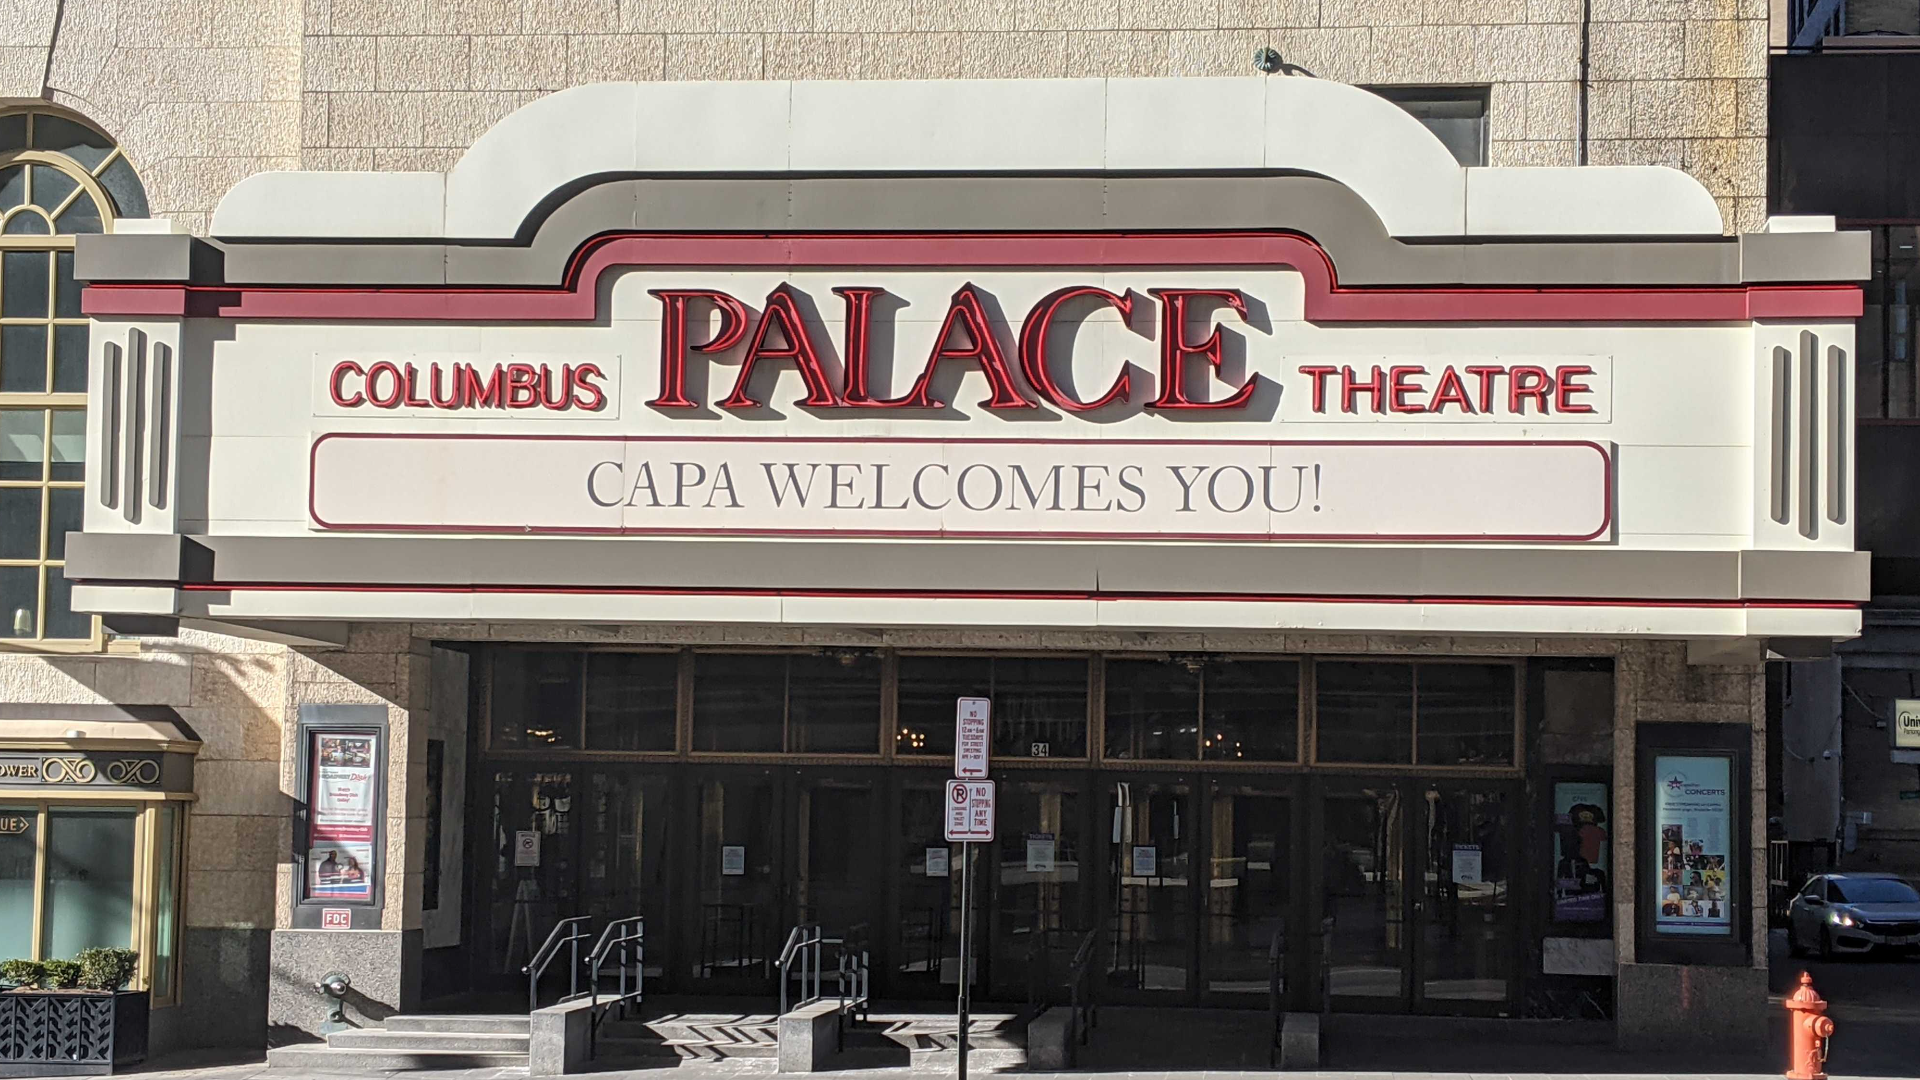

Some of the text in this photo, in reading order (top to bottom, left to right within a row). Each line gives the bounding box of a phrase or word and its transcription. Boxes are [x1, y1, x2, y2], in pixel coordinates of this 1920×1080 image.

[329, 281, 1593, 414] COLUMBUS PALACE THEATRE
[587, 461, 1321, 512] CAPA WELCOMES YOU!
[969, 710, 977, 718] NO
[962, 718, 985, 726] STOPPING
[1903, 715, 1920, 728] Uni
[1033, 744, 1048, 756] 34
[975, 787, 987, 797] NO
[971, 798, 991, 809] STOPPING
[974, 809, 987, 818] ANY
[974, 818, 988, 826] TIME
[326, 913, 347, 924] FDC
